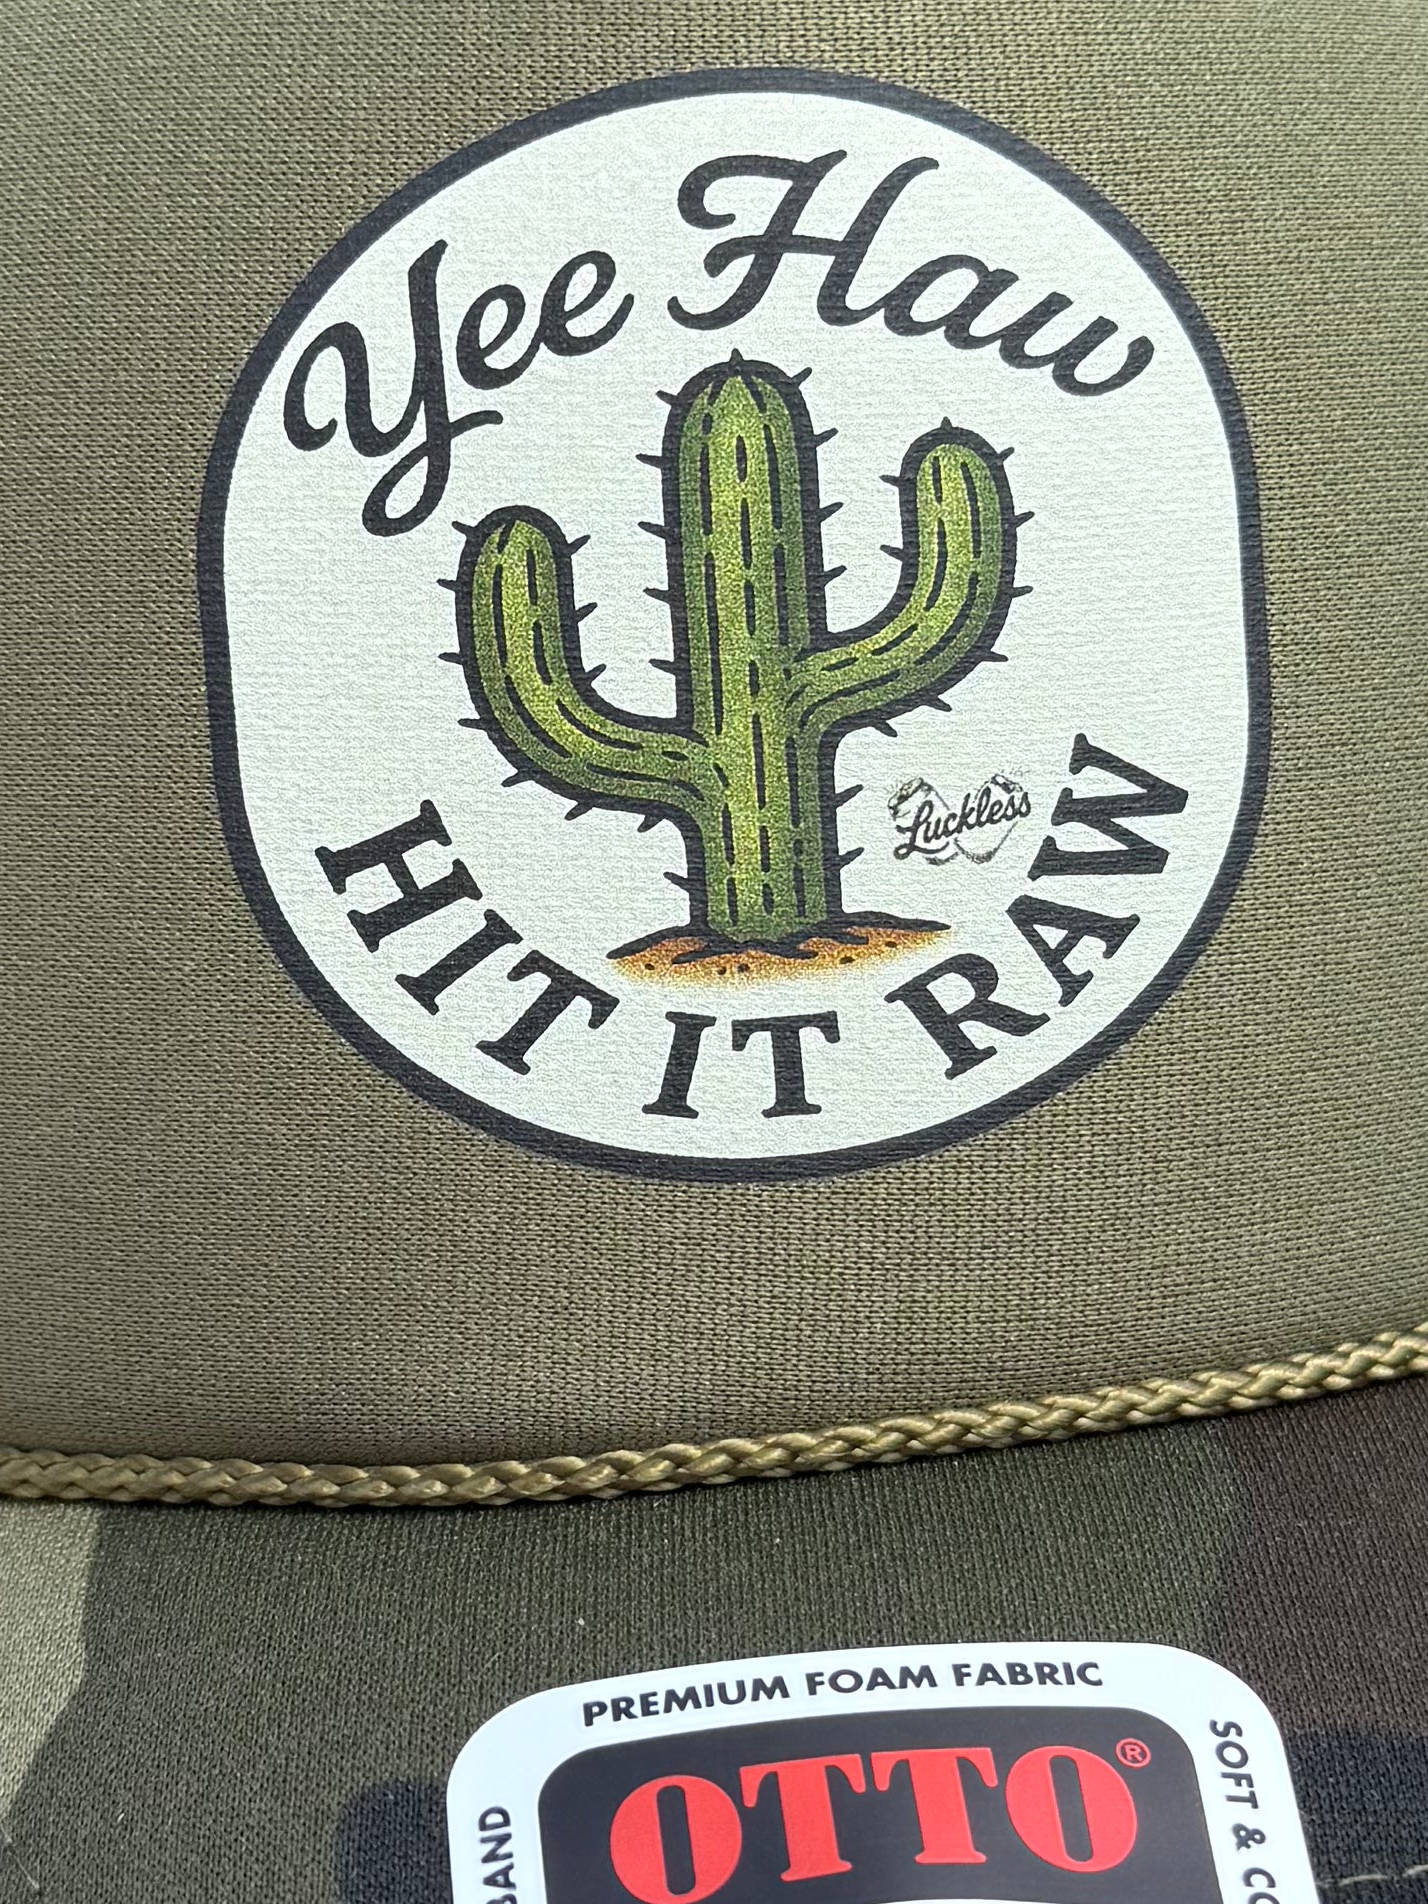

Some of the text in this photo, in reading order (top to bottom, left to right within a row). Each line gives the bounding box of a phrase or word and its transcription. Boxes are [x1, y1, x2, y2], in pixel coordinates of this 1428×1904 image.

[284, 150, 1156, 537] Yee Haw
[894, 786, 1032, 860] Luckless
[315, 733, 1189, 1119] HIT IT RAW
[582, 1661, 1104, 1728] PREMIUM FOAM FABRIC
[1209, 1718, 1260, 1809] SOFT
[1232, 1823, 1267, 1851] &
